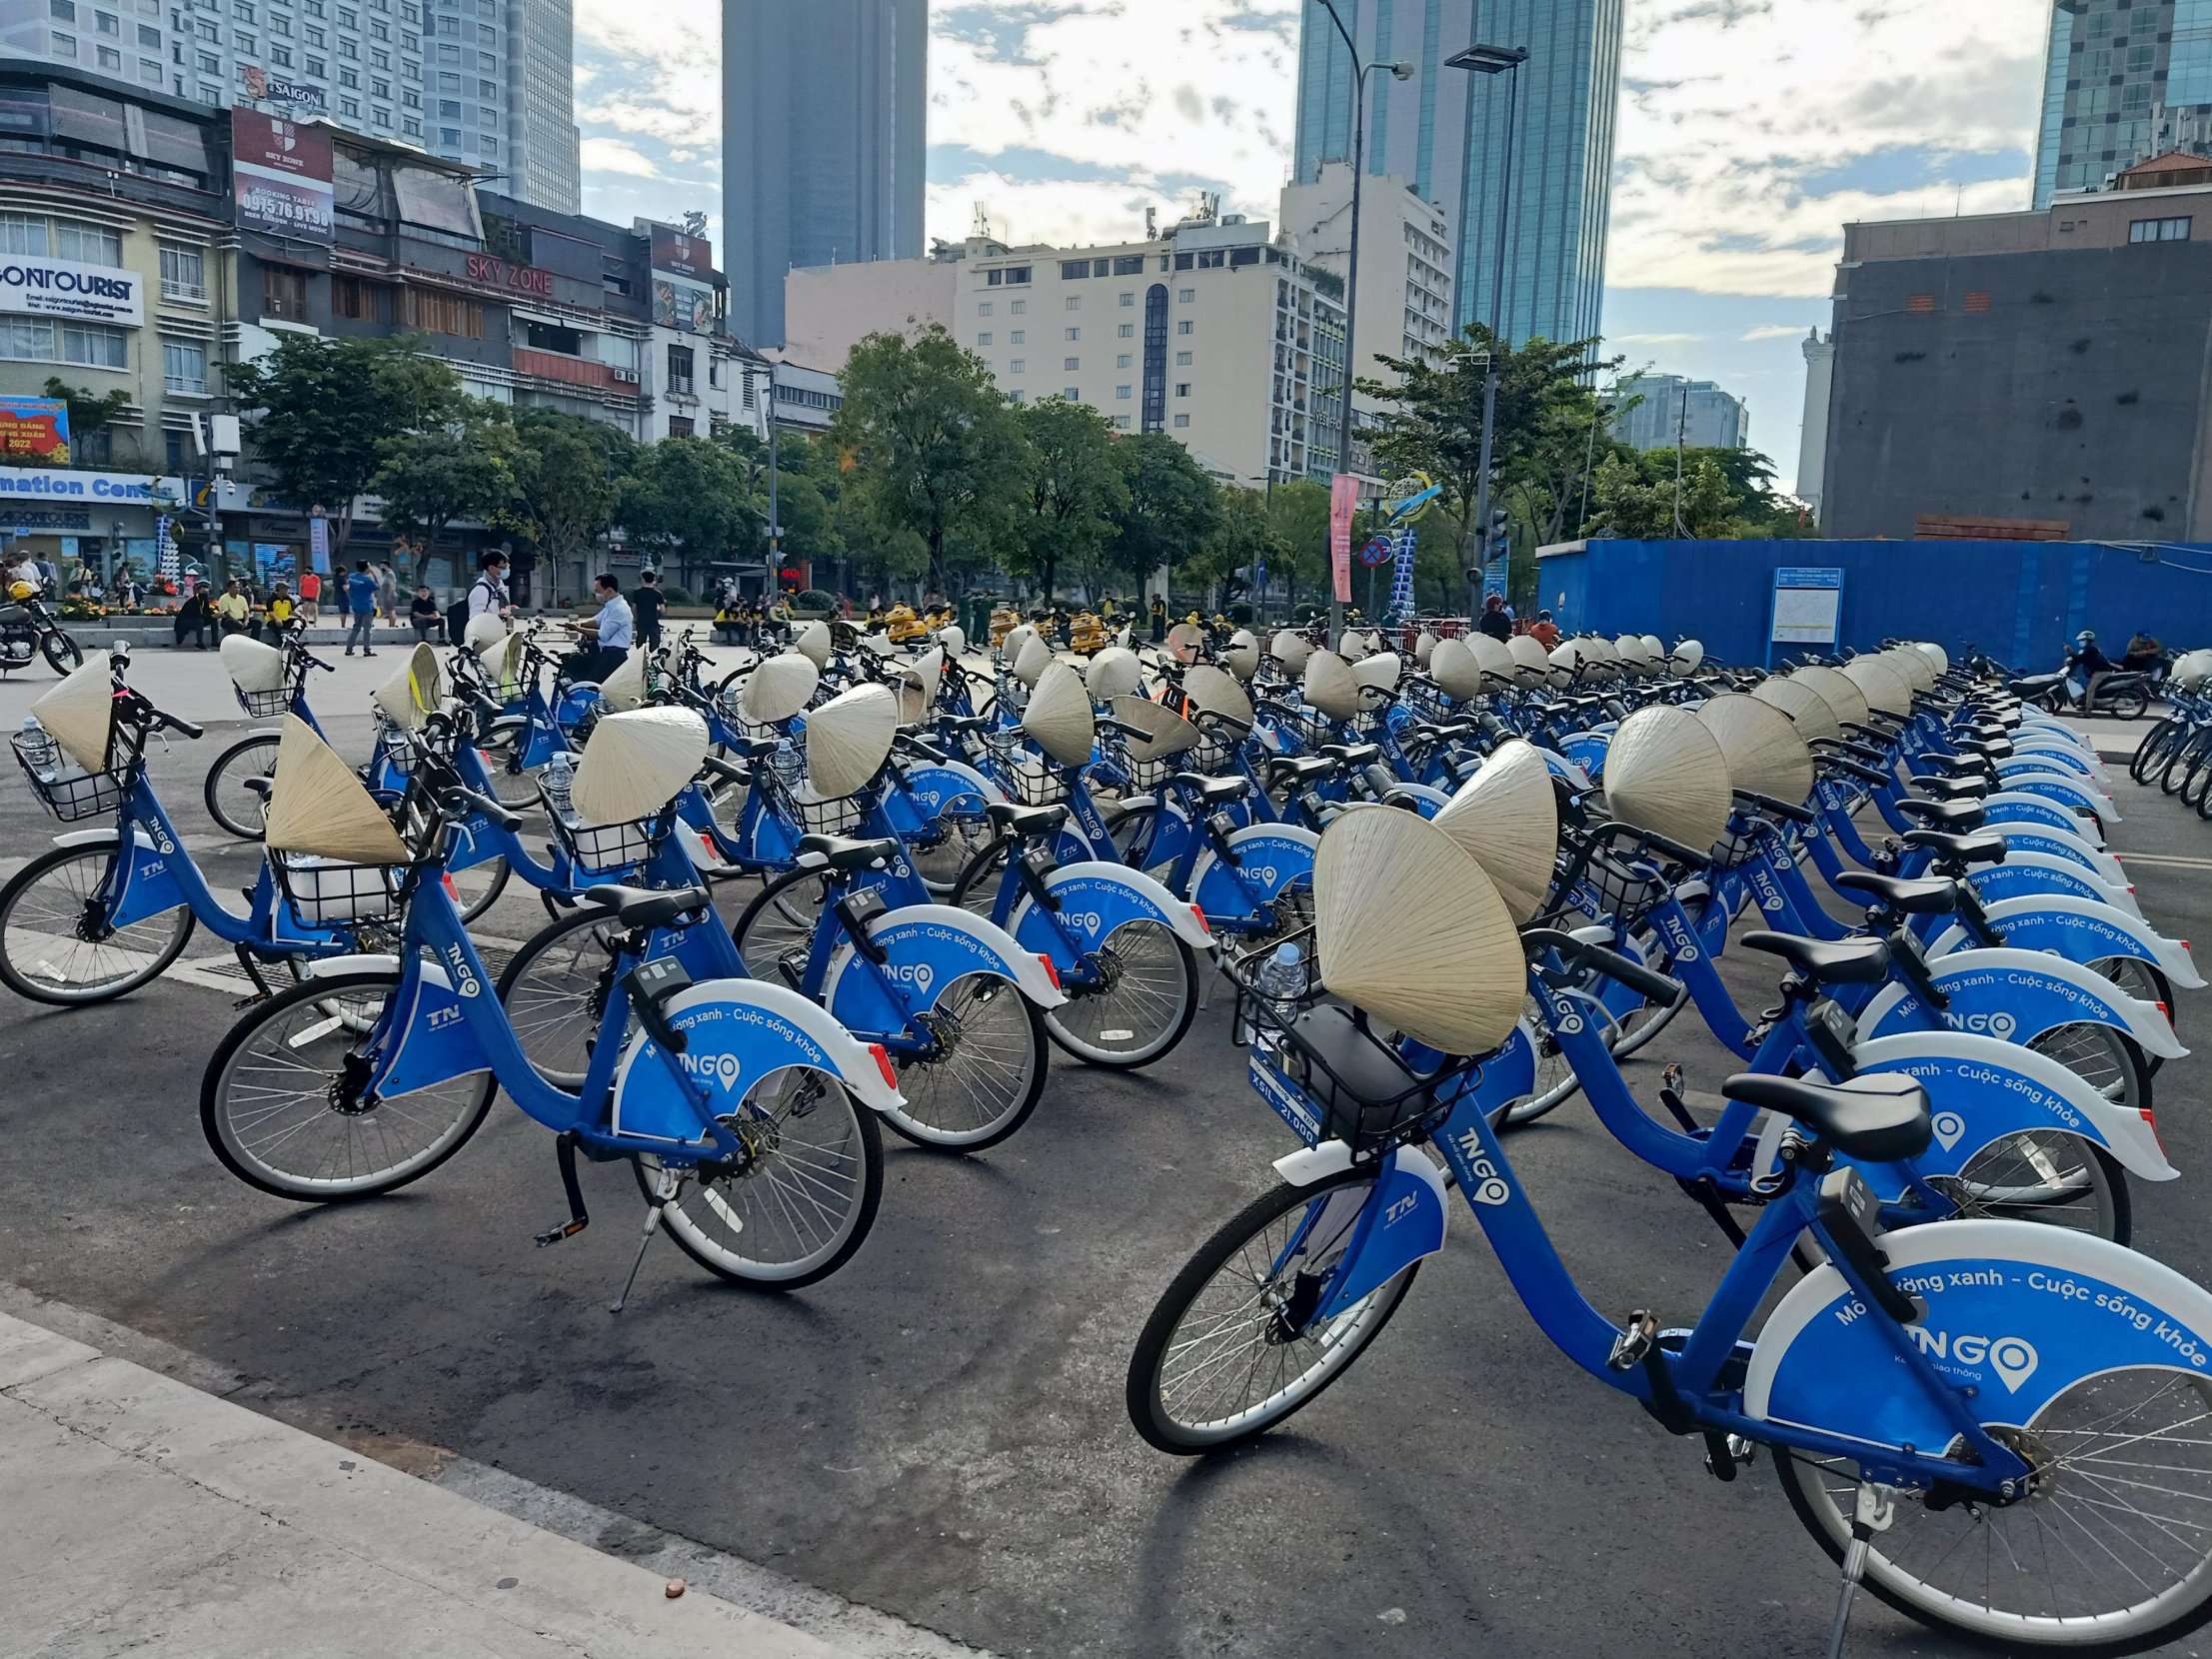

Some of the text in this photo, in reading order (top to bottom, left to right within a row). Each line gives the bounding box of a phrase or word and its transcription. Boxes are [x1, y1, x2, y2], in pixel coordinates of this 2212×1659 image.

[275, 82, 319, 105] SAIGON
[255, 187, 291, 201] BOOKING
[468, 256, 553, 295] SKY ZONE
[151, 815, 175, 853] TNGO
[1082, 808, 1104, 839] TNGO
[2022, 837, 2045, 848] Cuộc
[1069, 882, 1088, 893] xanh
[1095, 881, 1117, 894] Cuộc
[1117, 888, 1139, 904] sống
[1138, 898, 1158, 917] khỏe
[1755, 869, 1784, 911] TNGO
[1991, 870, 2014, 880] xanh
[2023, 868, 2049, 880] Cuộc
[2050, 872, 2073, 888] sống
[2074, 881, 2095, 900] khỏe
[896, 925, 919, 940] xanh
[927, 926, 953, 941] Cuộc
[954, 934, 978, 953] sống
[978, 945, 1001, 970] khỏe
[1666, 914, 1699, 962] TNGO
[2017, 915, 2045, 927] xanh
[2055, 915, 2086, 929] Cuộc
[2087, 921, 2115, 940] sống
[2114, 931, 2142, 955] khỏe
[448, 941, 481, 998] TNGO
[426, 1003, 461, 1026] TN
[1962, 973, 1995, 987] xanh
[2007, 973, 2043, 988] Cuộc
[2045, 981, 2077, 1001] sống
[2078, 994, 2109, 1020] khỏe
[697, 1007, 723, 1024] xanh
[733, 1007, 765, 1025] Cuộc
[766, 1017, 795, 1041] sống
[795, 1032, 823, 1063] khỏe
[1957, 1064, 2001, 1085] Cuộc
[2003, 1077, 2044, 1103] sống
[2043, 1095, 2081, 1128] khỏe
[1458, 1126, 1510, 1206] TNGO
[1384, 1189, 1418, 1222] TN
[1947, 1268, 2004, 1287] xanh
[2027, 1271, 2091, 1300] Cuộc
[2094, 1295, 2153, 1331] sống
[2152, 1319, 2207, 1368] khỏe
[1952, 1367, 1983, 1382] thông
